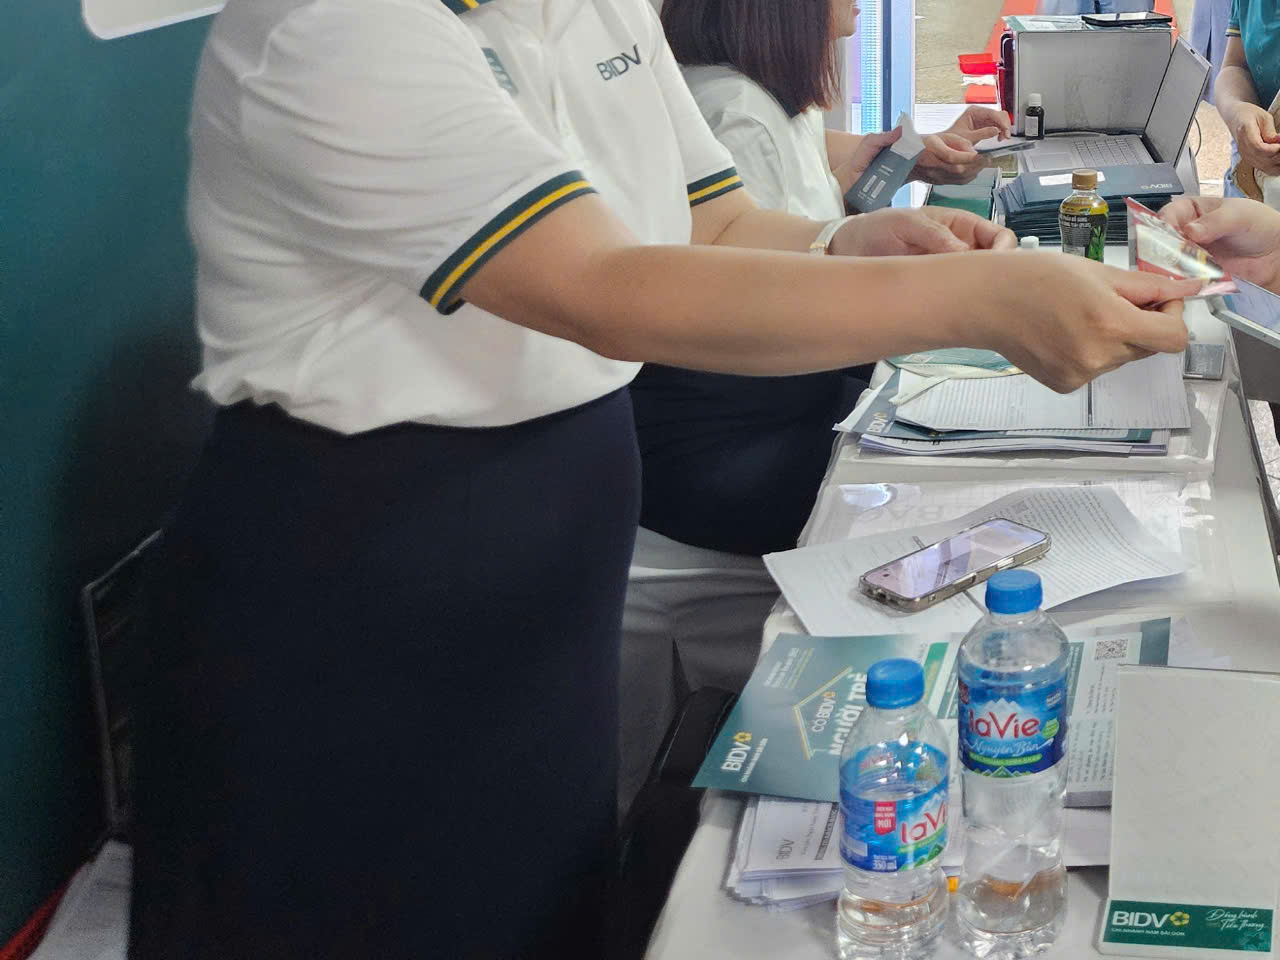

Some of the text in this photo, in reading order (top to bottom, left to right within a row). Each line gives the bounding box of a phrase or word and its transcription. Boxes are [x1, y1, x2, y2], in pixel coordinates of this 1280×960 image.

[596, 43, 642, 81] BIDV
[967, 708, 1041, 739] laVie
[720, 741, 753, 773] BIDV
[1111, 910, 1171, 929] BIDV
